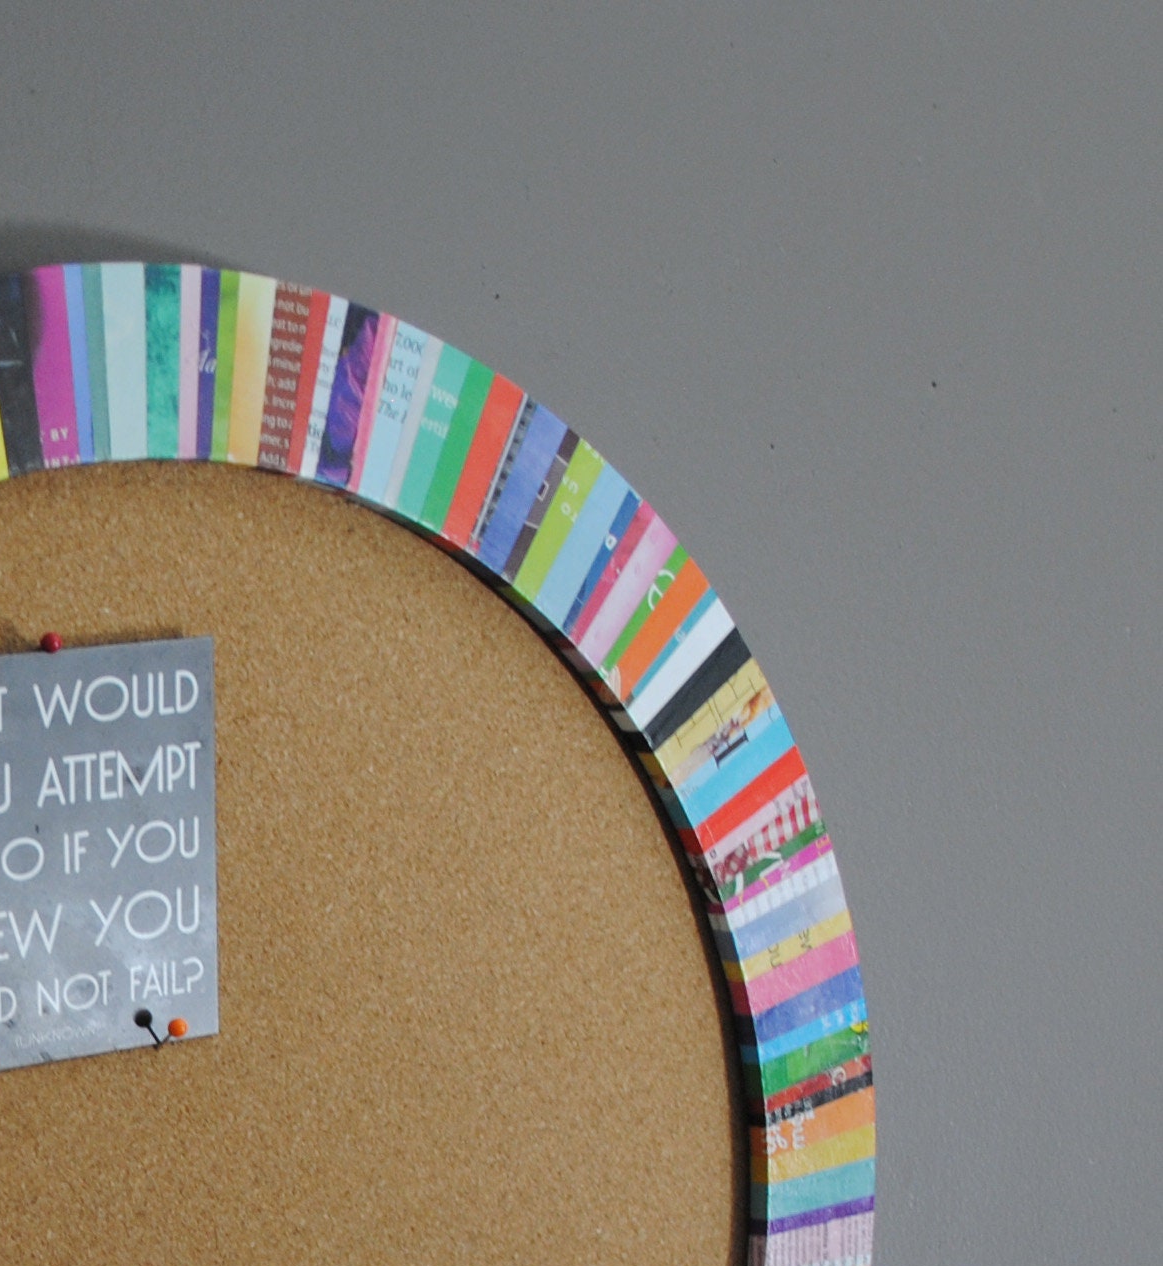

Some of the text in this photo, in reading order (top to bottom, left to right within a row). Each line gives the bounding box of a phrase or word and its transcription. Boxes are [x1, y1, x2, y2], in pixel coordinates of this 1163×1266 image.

[34, 669, 199, 729] WOULD
[37, 741, 202, 808] ATTEMPT
[63, 830, 90, 875] IF
[106, 815, 200, 869] YOU
[89, 885, 200, 947] YOU
[37, 970, 112, 1017] NOT
[129, 956, 205, 1002] FAIL?
